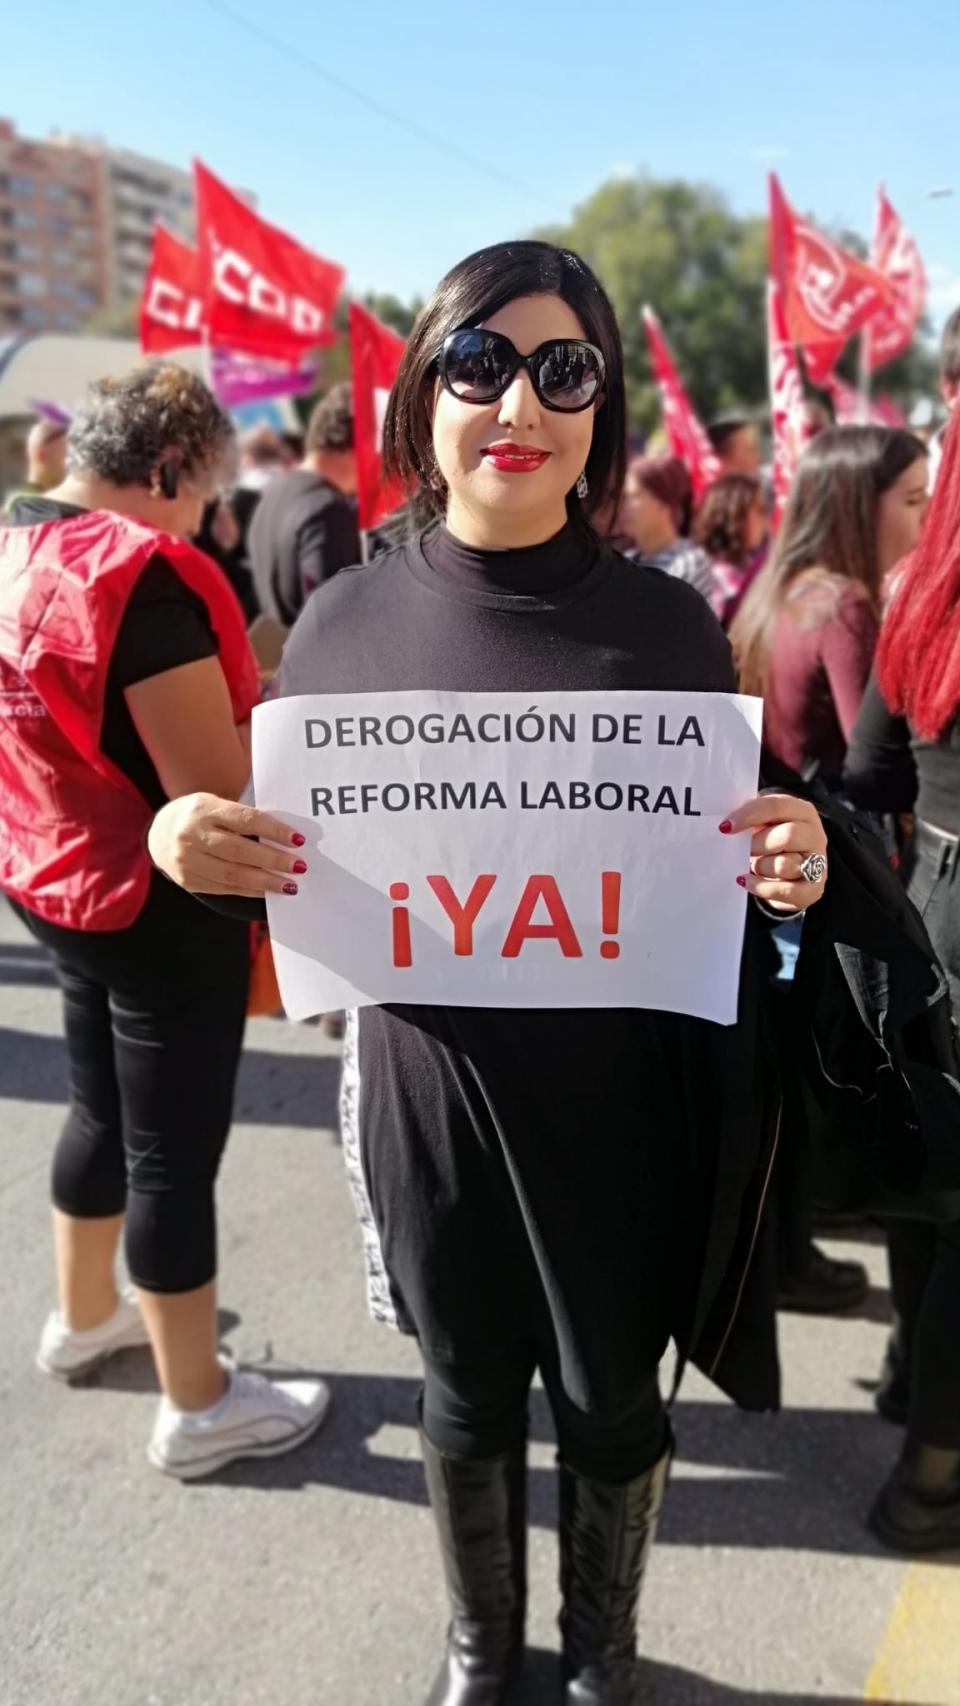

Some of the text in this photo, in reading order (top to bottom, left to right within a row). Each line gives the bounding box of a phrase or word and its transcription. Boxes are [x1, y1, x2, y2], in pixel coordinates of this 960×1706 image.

[305, 705, 705, 749] DEROGACIÓN DE LA
[311, 781, 701, 816] REFORMA LABORAL
[389, 871, 621, 967] ¡YA!
